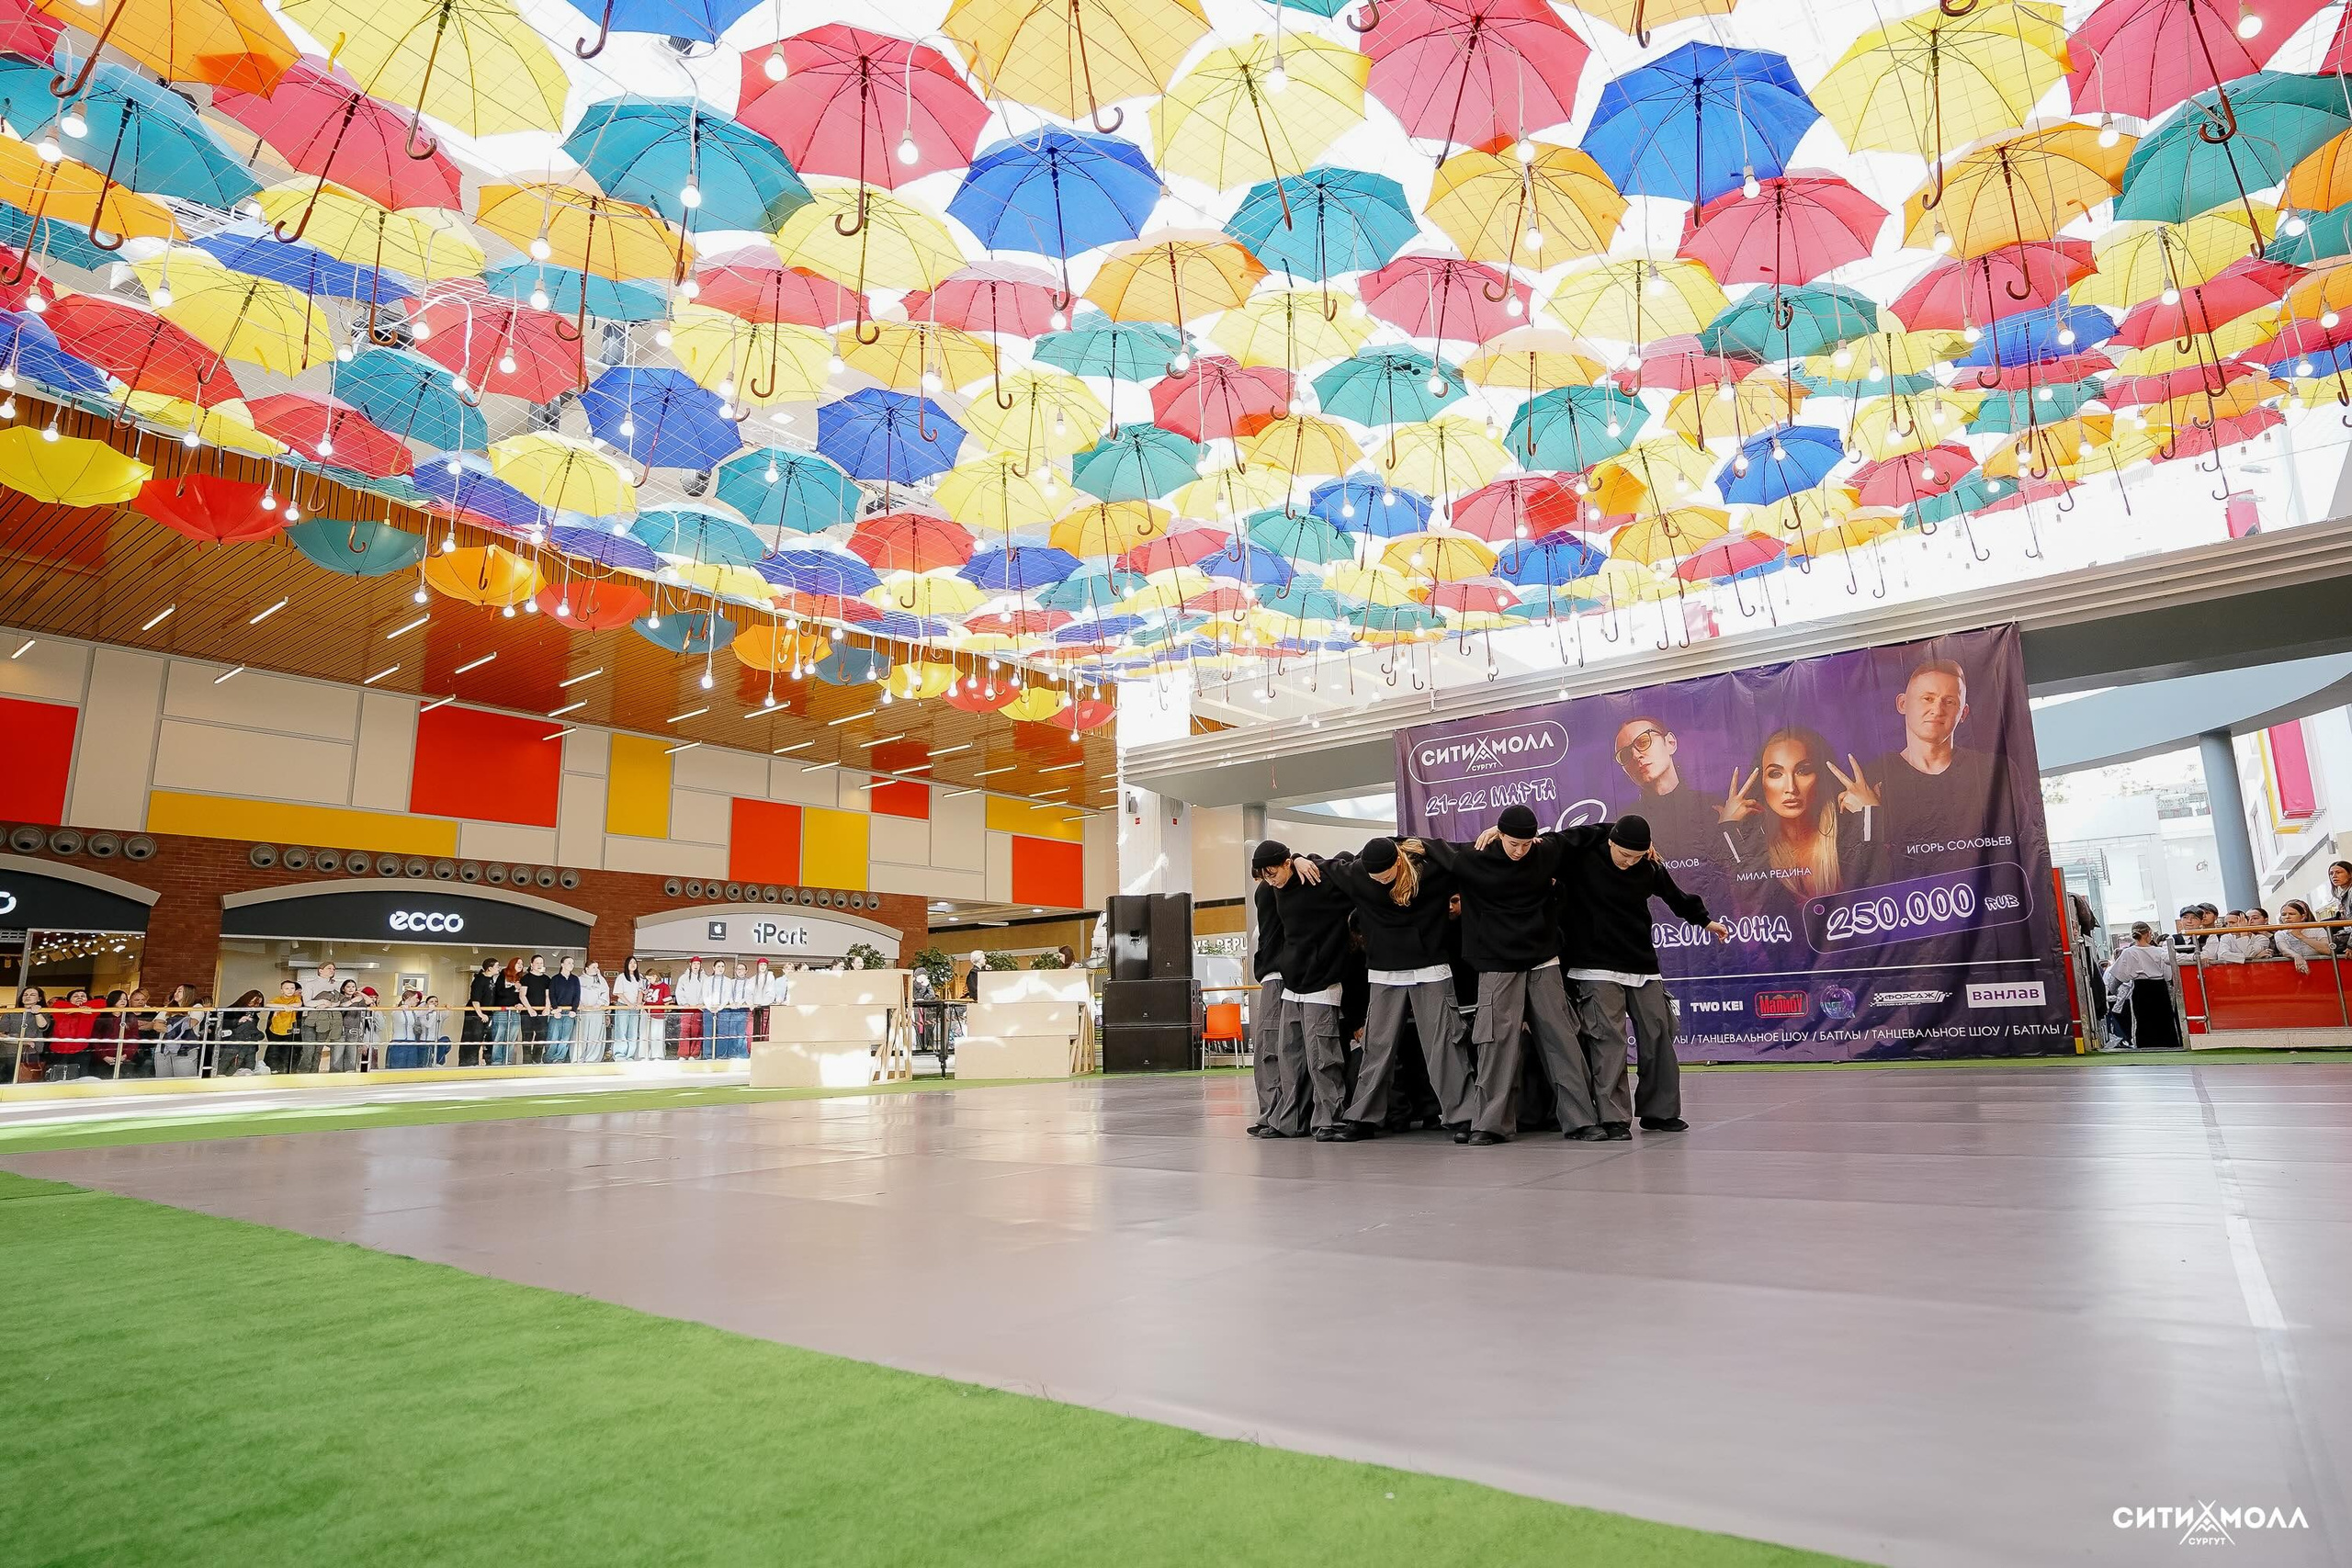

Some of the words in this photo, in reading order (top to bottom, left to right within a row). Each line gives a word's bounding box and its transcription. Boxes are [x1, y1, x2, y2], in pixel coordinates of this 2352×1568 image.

[1471, 761, 1498, 772] СУРГУТ
[1425, 790, 1487, 817] 21-22
[1490, 778, 1556, 807] МАРТА
[1906, 842, 1945, 854] ИГОРЬ
[1947, 836, 2012, 851] СОЛОВЬЕВ
[1736, 871, 1768, 882] МИЛА
[1770, 867, 1812, 879] РЕДИНА
[1826, 883, 1975, 941] 250.000
[1984, 894, 2019, 911] RUB
[389, 910, 464, 933] ecco
[753, 922, 808, 945] iPort
[1884, 992, 1935, 1000] ФОРСАЖ
[1972, 987, 2040, 1002] ванлав
[1690, 1001, 1720, 1012] TWO
[1722, 1000, 1744, 1011] KEI
[1697, 1032, 1779, 1045] ТАНЦЕВАЛЬНОЕ
[1781, 1031, 1809, 1043] ШОУ
[1820, 1030, 1861, 1042] БАТТЛЫ
[1871, 1027, 1966, 1040] ТАНЦЕВАЛЬНОЕ
[1969, 1025, 2000, 1037] ШОУ
[2013, 1024, 2061, 1036] БАТТЛЫ
